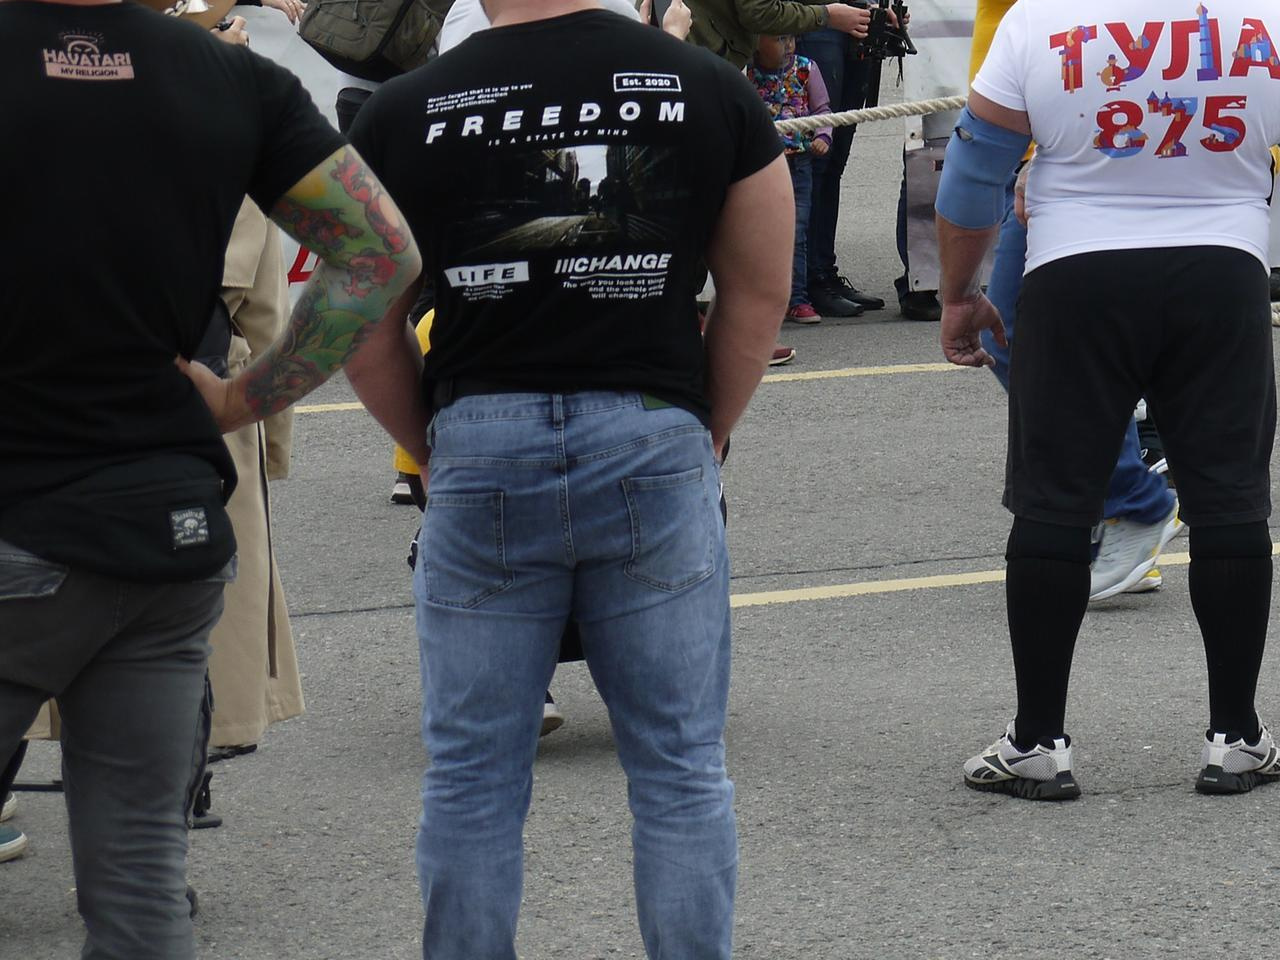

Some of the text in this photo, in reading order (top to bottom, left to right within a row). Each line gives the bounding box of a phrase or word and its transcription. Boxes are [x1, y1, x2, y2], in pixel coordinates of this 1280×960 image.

[61, 67, 119, 77] MY RELIGION
[622, 77, 671, 87] Est. 2020
[426, 101, 685, 144] FREEDOM
[1093, 92, 1248, 158] 875
[526, 132, 565, 142] STATE
[458, 267, 515, 281] LIFE
